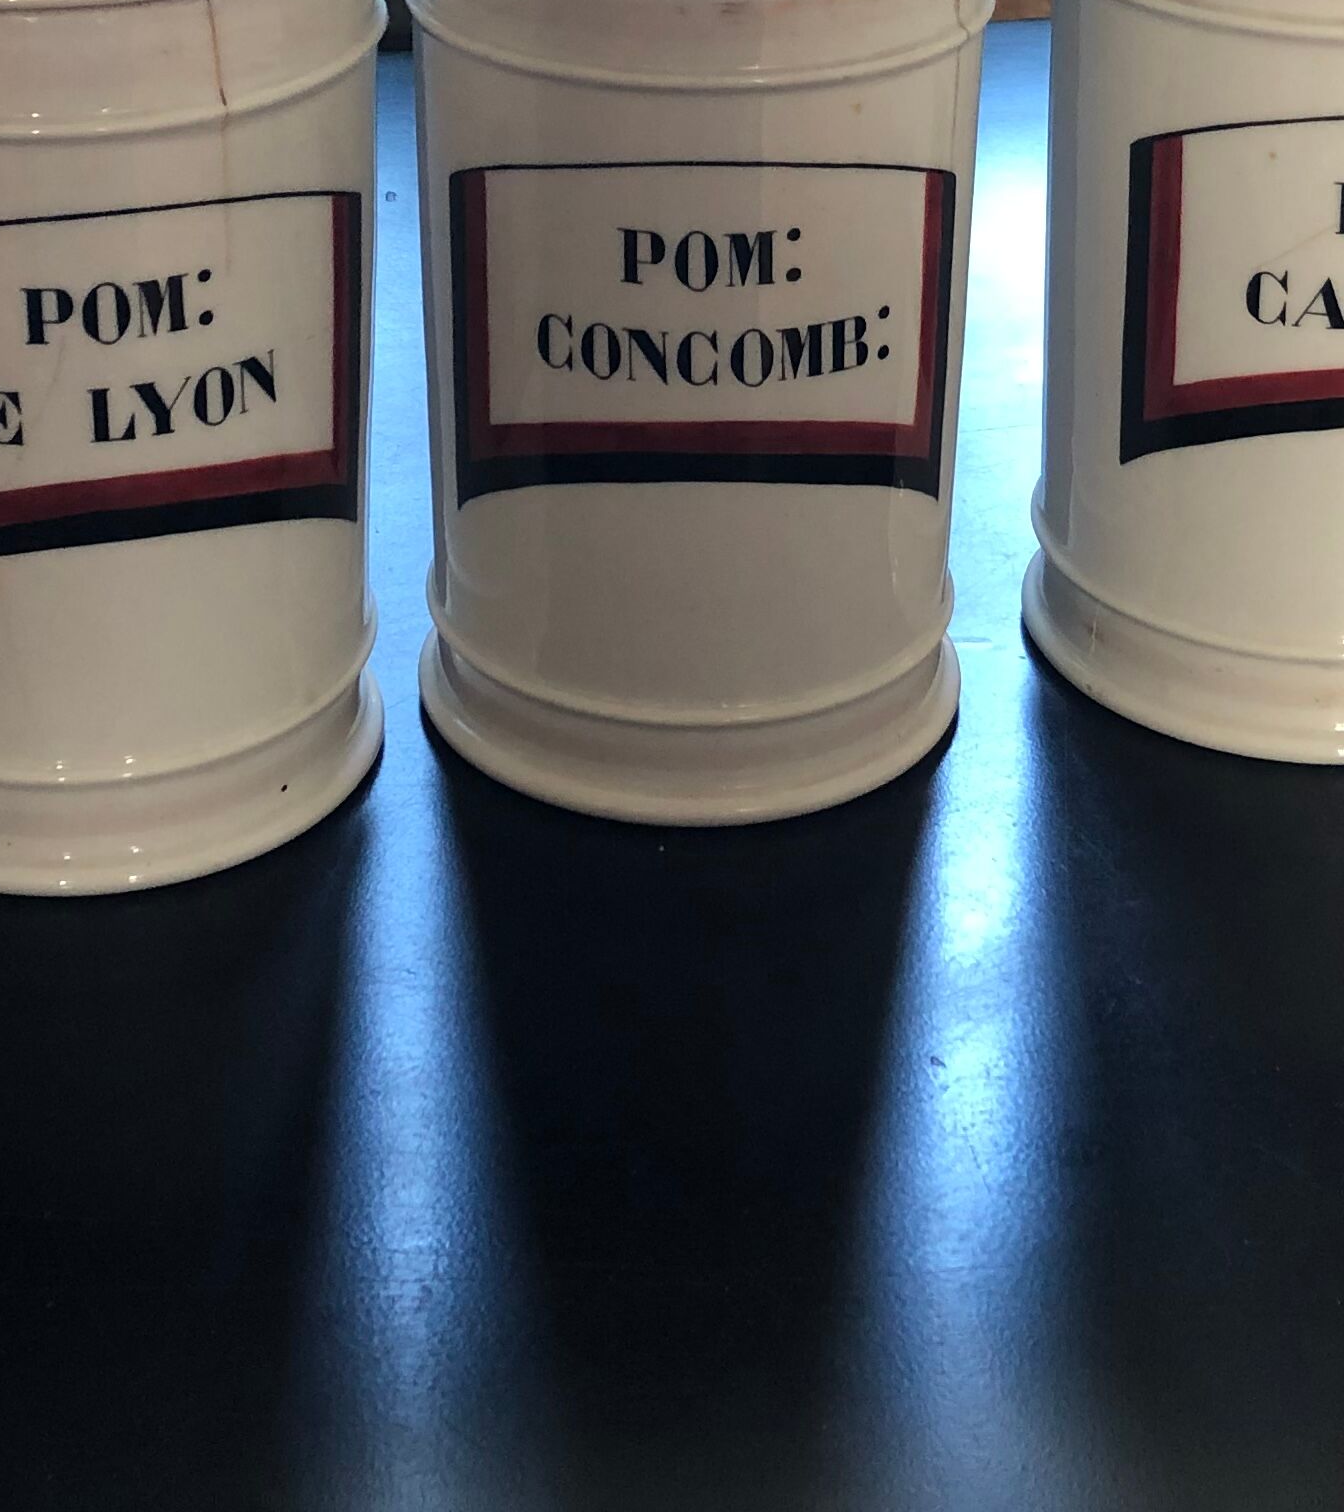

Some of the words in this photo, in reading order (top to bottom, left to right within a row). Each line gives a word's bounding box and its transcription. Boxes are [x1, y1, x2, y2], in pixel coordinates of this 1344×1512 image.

[617, 227, 801, 292] POM:
[20, 268, 214, 345] POM:
[537, 305, 891, 387] CONCOMB:
[87, 349, 277, 443] LYON
